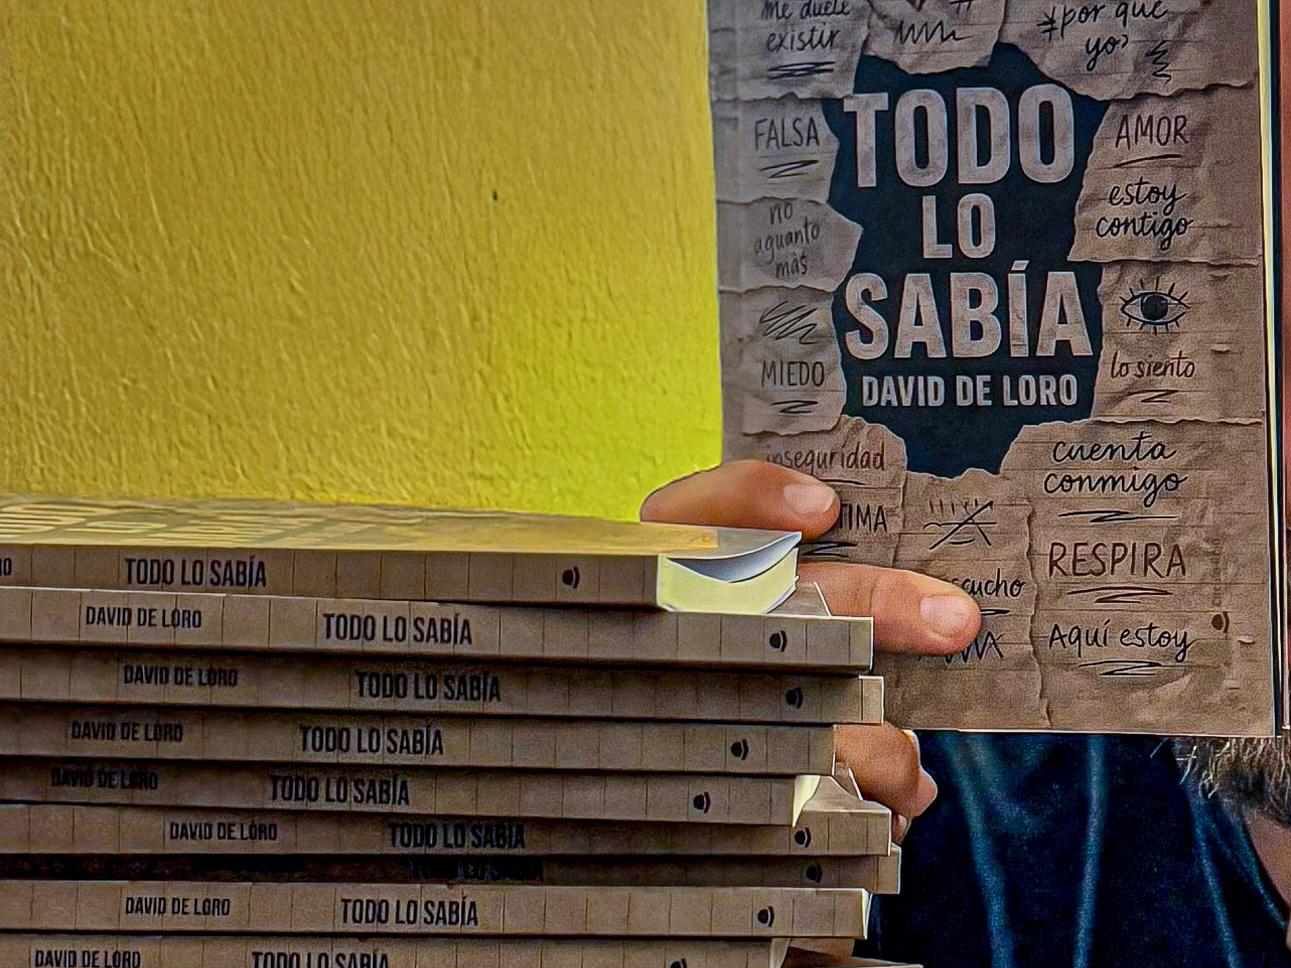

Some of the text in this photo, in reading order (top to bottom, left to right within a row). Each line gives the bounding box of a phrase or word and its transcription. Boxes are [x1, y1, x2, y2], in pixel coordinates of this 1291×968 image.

[766, 22, 841, 51] existir
[754, 118, 820, 150] FALSA
[843, 83, 1075, 187] TODO
[1115, 115, 1188, 150] AMOR
[1109, 177, 1187, 216] estoy
[769, 203, 793, 225] no
[922, 193, 995, 259] LO
[754, 217, 820, 264] aguanto
[1096, 213, 1194, 250] contigo
[776, 252, 808, 277] más
[845, 261, 1093, 360] SABÍA
[761, 360, 825, 387] MIEDO
[1111, 350, 1195, 378] lo siento
[862, 374, 1077, 407] DAVID DE LORO
[766, 441, 884, 476] nseguridad
[1053, 430, 1177, 463] cuenta
[1044, 466, 1188, 508] conmigo
[839, 504, 887, 533] TIMA
[126, 555, 266, 588] TODO LO SABÍA
[1049, 542, 1186, 579] RESPIRA
[86, 606, 201, 628] DAVID DE LORO
[323, 613, 472, 644] TODO LO SABÍA
[1049, 618, 1196, 663] Aquí estoy
[355, 669, 500, 702] TODO LO SABÍA
[71, 720, 183, 742] DAVID DE LORO
[300, 723, 443, 755] TODO LO SABÍA
[270, 773, 409, 806] TODO LO SABÍA
[170, 822, 277, 841] DAVID DE LORO
[126, 897, 230, 916] DAVID DE LORO
[341, 895, 477, 927] TODO LO SABÍA
[34, 950, 141, 968] DAVID DE LORO
